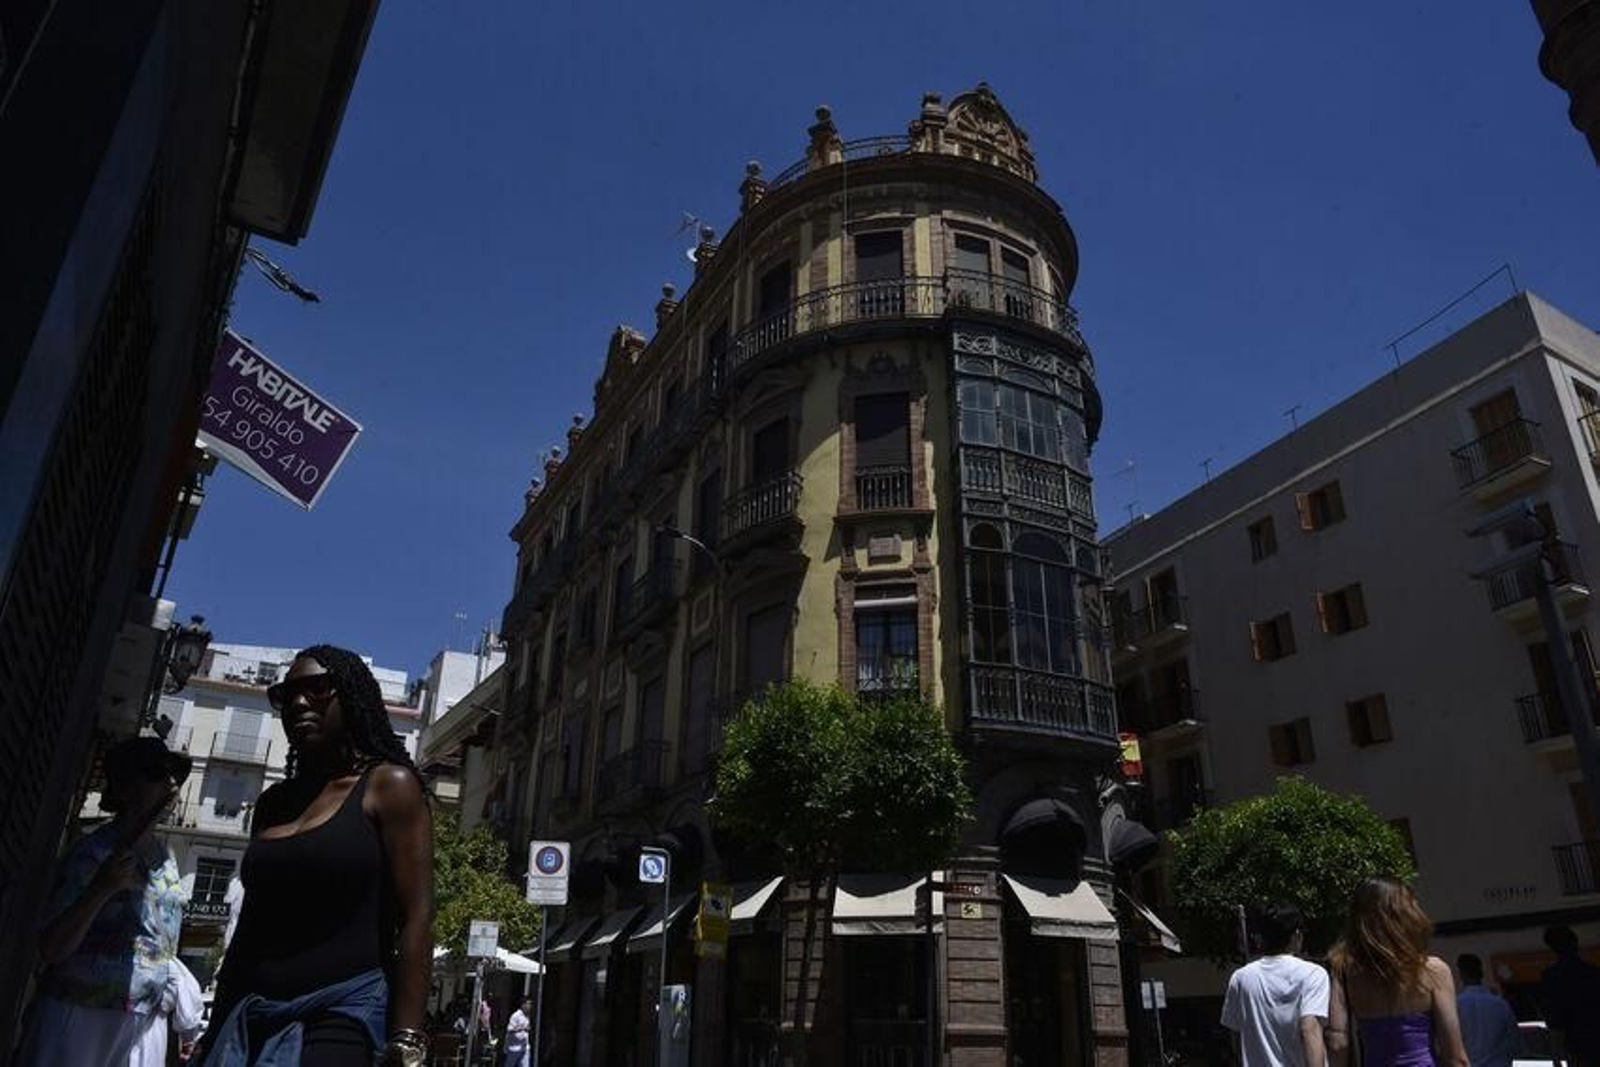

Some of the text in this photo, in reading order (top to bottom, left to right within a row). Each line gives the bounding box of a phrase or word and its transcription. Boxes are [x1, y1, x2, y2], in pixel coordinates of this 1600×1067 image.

[227, 347, 337, 434] HABITALE
[231, 385, 304, 445] Giraldo
[231, 419, 280, 460] 905
[277, 452, 319, 485] 410
